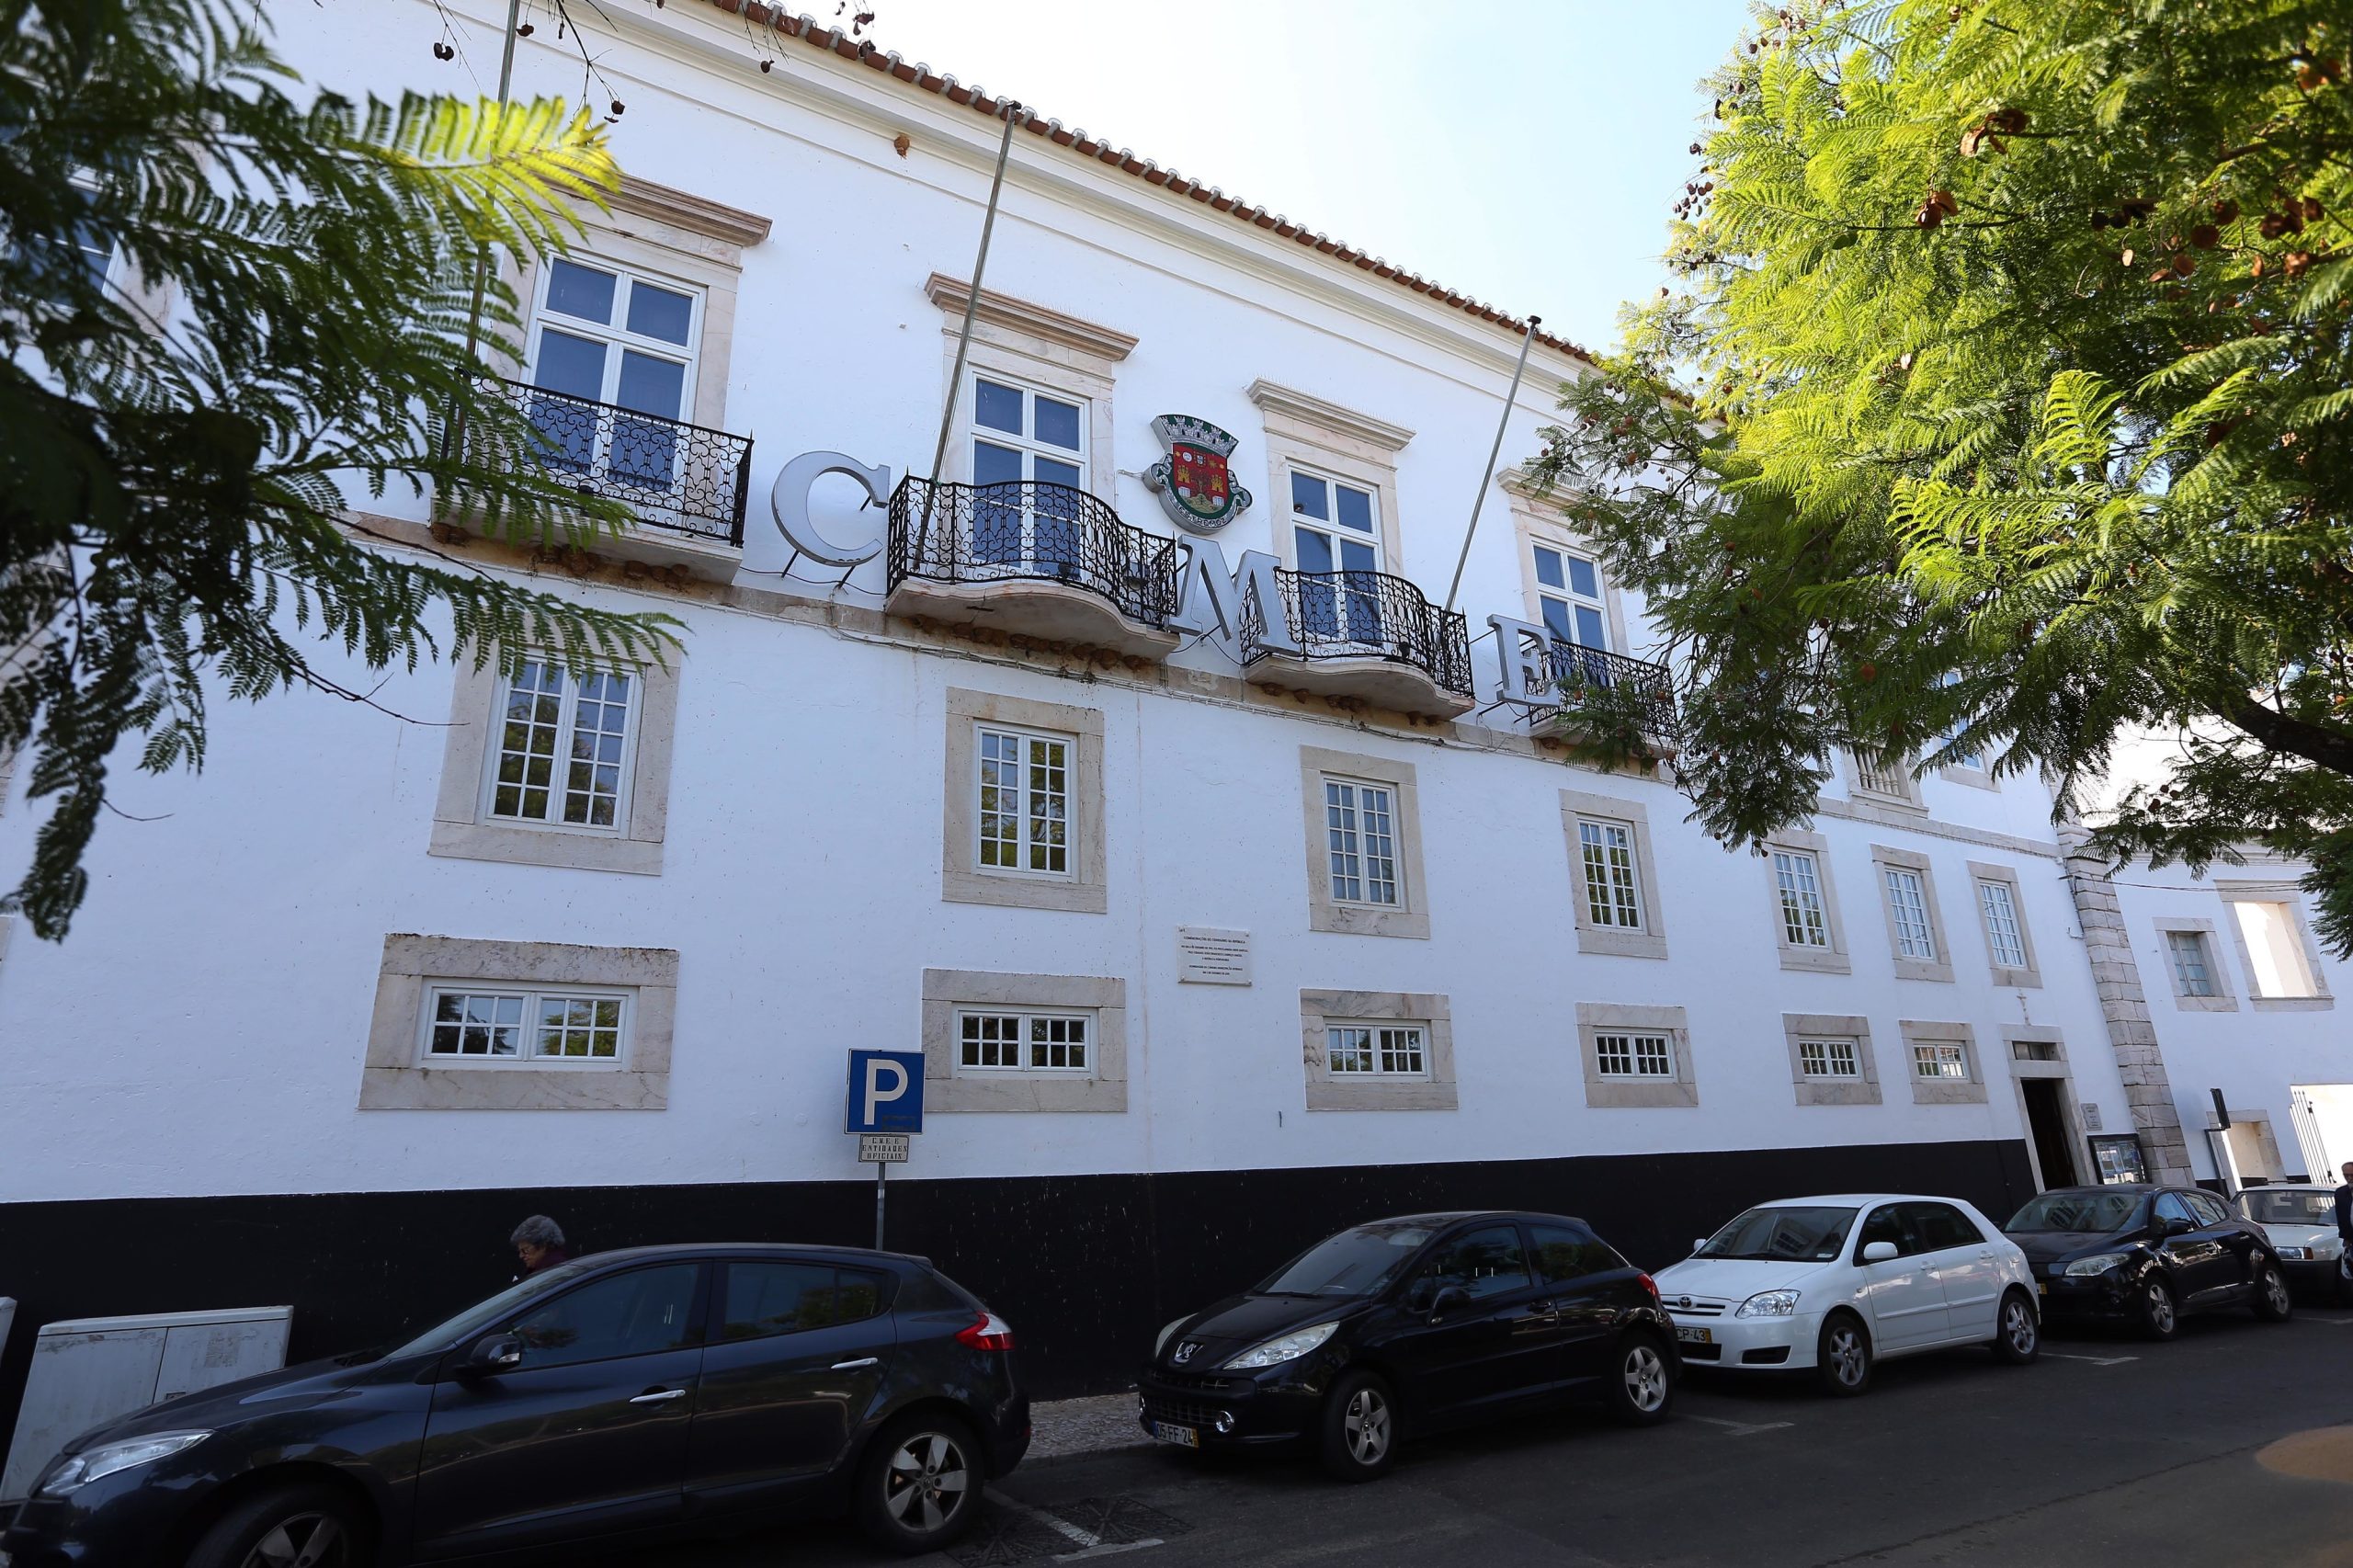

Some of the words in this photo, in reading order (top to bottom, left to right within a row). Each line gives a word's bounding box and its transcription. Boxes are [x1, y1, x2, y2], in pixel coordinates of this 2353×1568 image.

[771, 450, 891, 568] C
[1164, 534, 1302, 657] M
[1486, 614, 1561, 707] E
[864, 1059, 908, 1125] P
